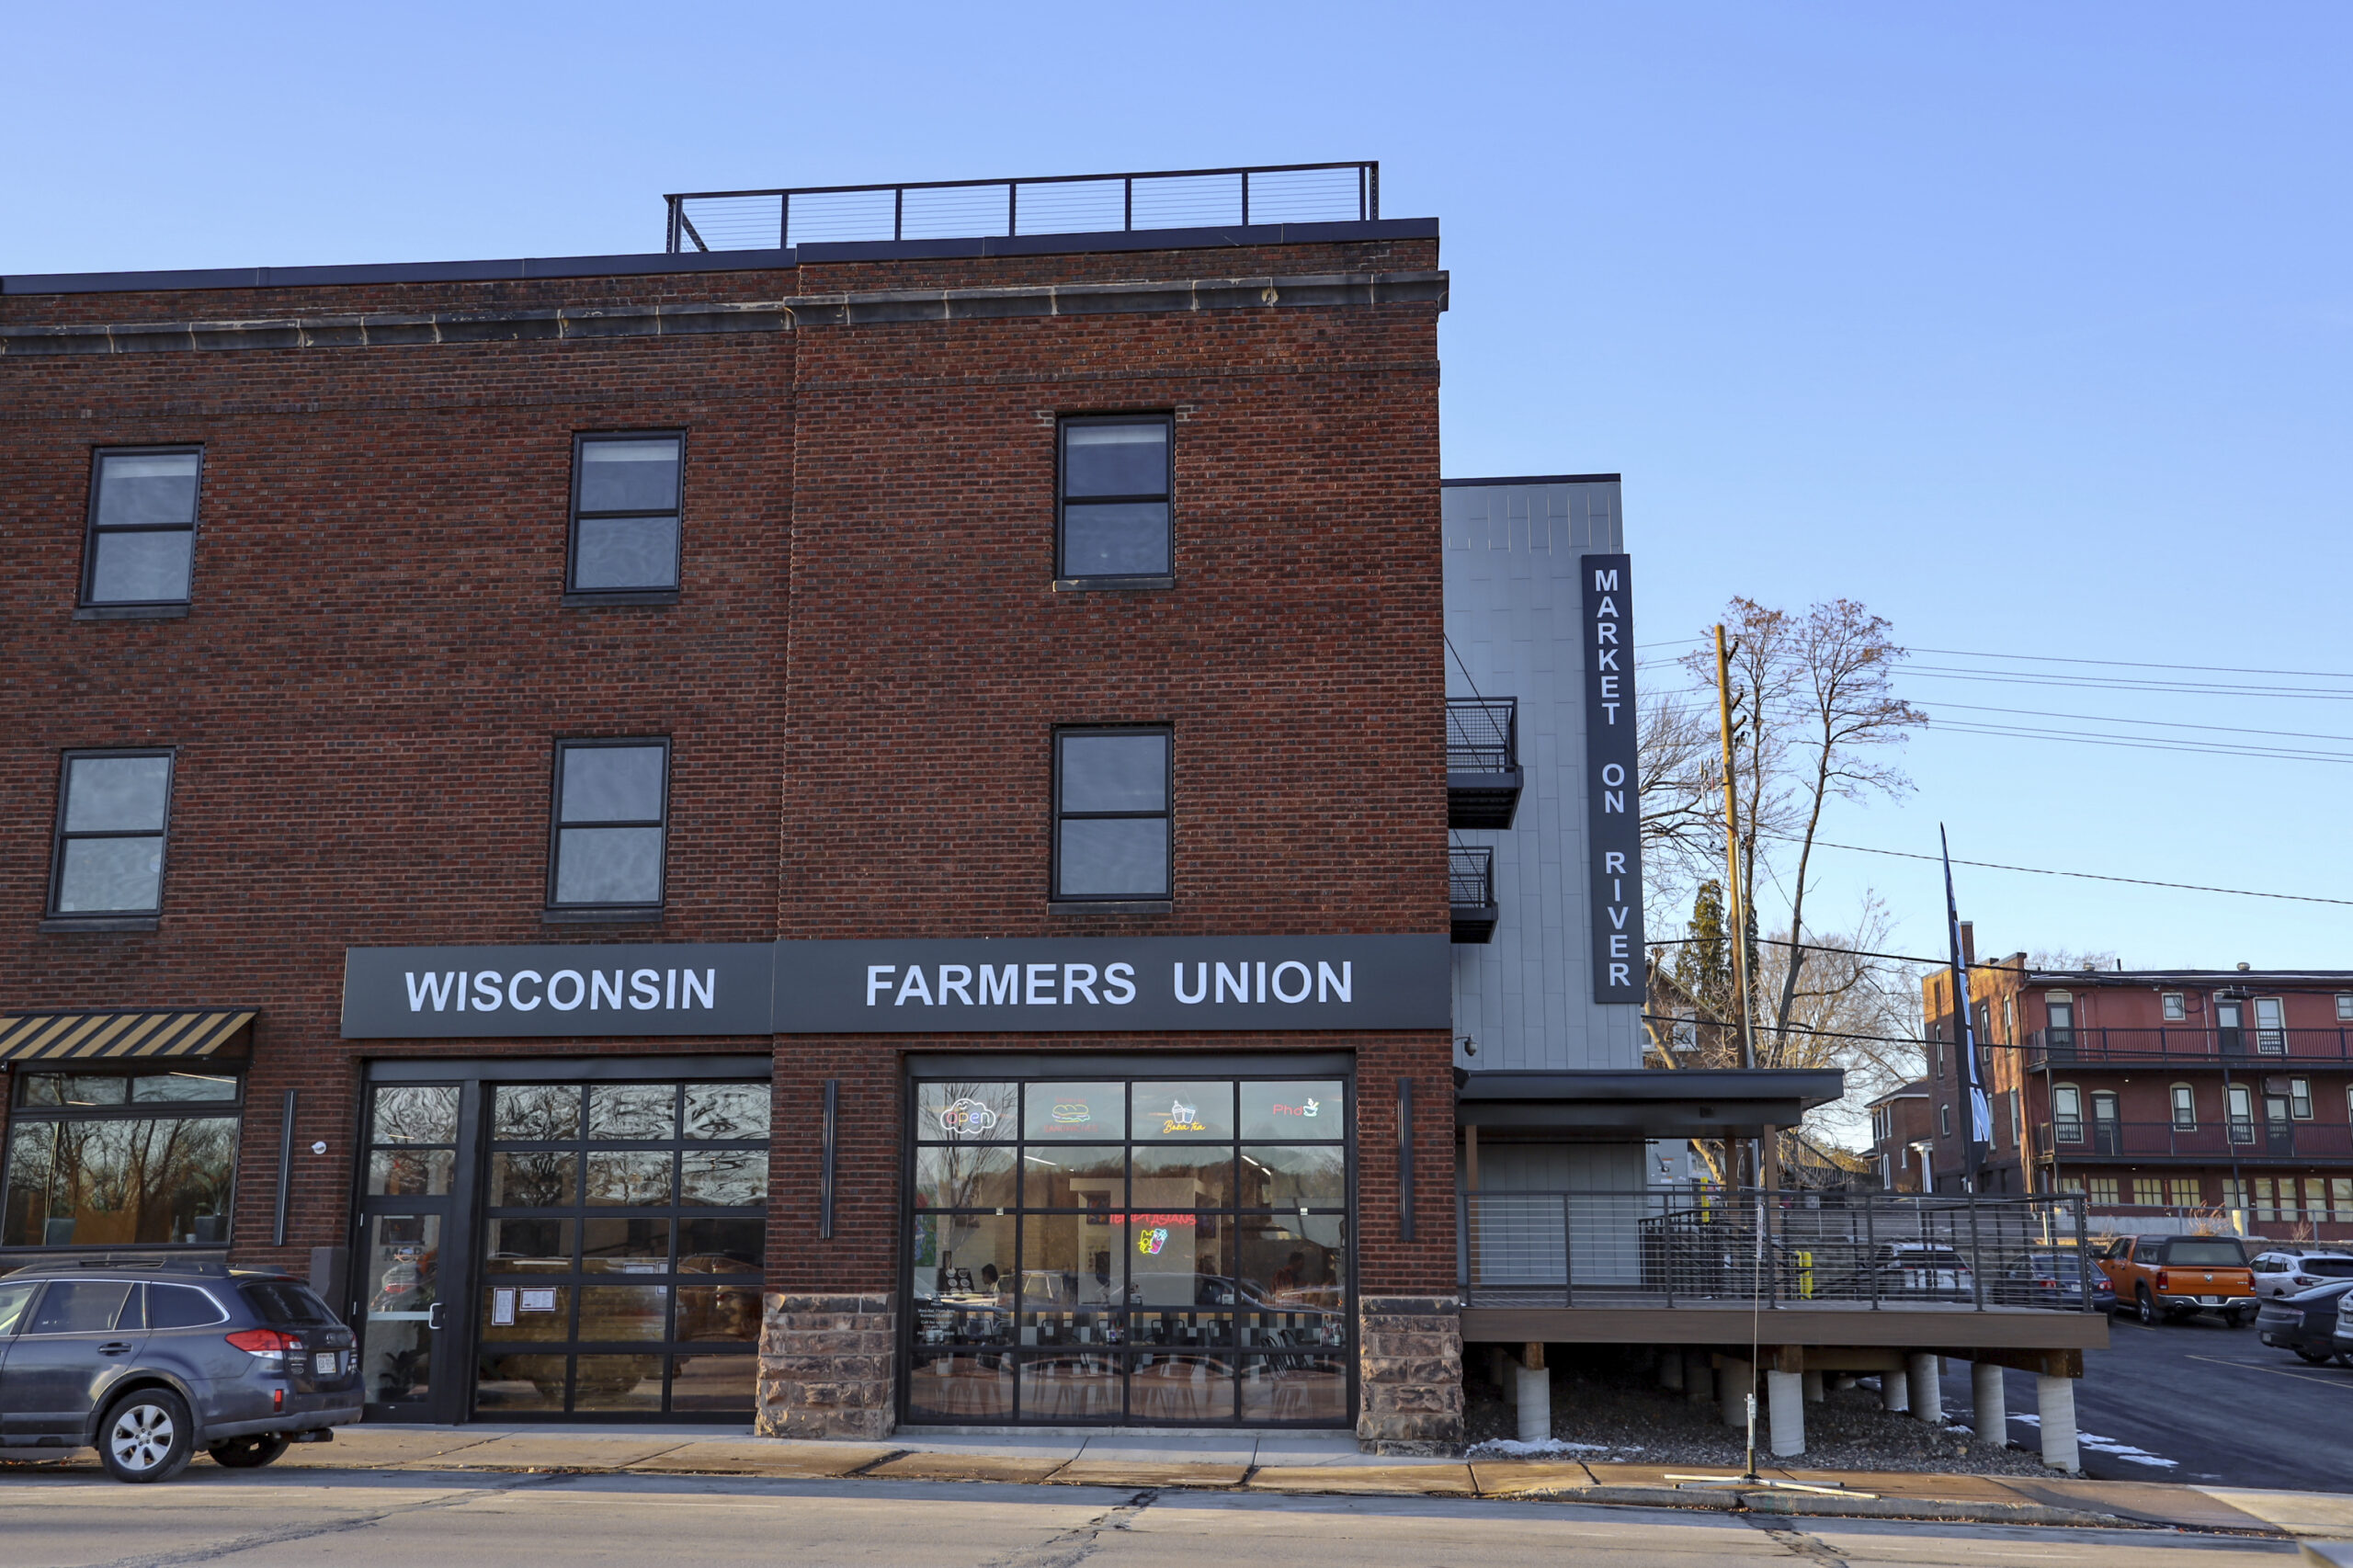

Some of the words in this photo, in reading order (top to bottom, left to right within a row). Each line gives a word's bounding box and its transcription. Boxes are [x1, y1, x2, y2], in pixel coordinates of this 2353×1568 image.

[1595, 569, 1620, 725] MARKET
[1602, 763, 1625, 813] ON
[1606, 851, 1631, 986] RIVER
[405, 968, 715, 1012] WISCONSIN
[866, 961, 1136, 1006] FARMERS
[1174, 960, 1352, 1005] UNION
[946, 1111, 990, 1127] open
